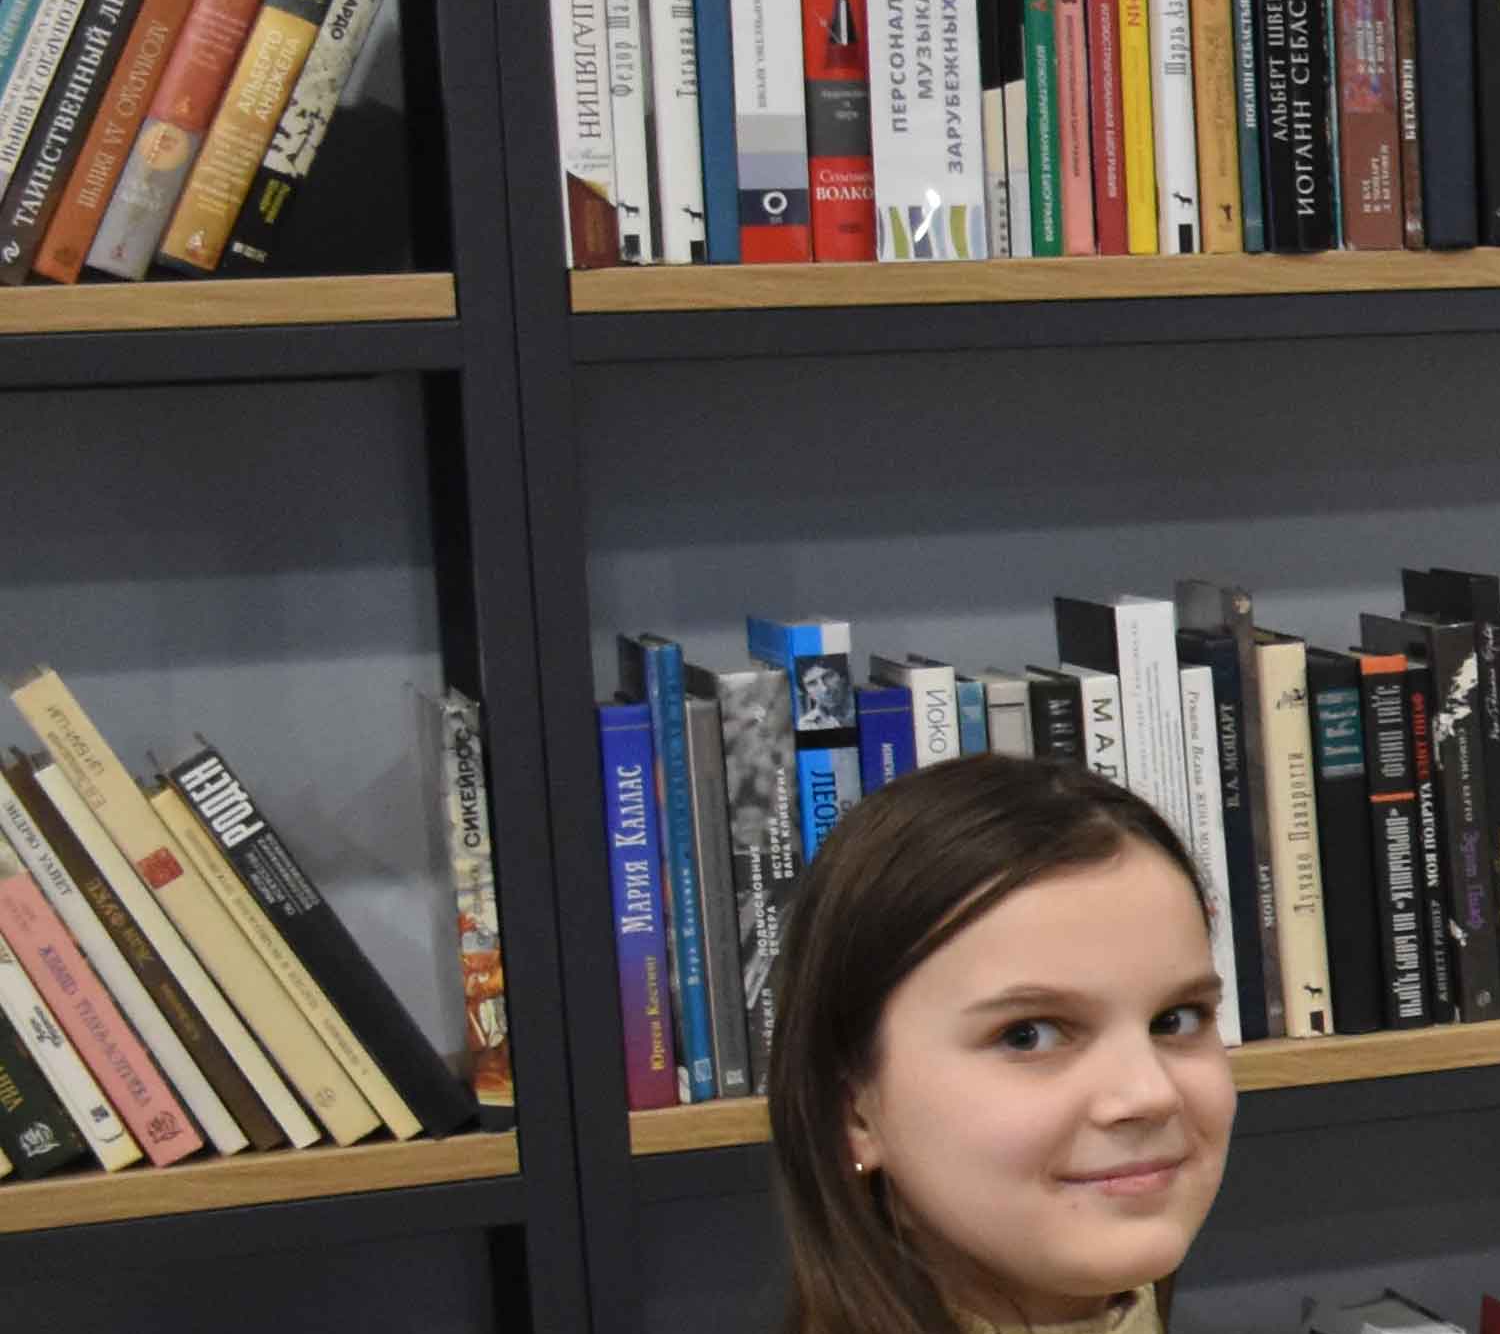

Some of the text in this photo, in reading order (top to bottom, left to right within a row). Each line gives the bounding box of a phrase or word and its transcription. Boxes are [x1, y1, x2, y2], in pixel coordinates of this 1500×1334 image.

[14, 26, 110, 228] ТАИНСТВЕННЫЙ
[1271, 57, 1288, 140] АЛЬБЕРТ
[1403, 59, 1416, 140] БЕТХОВЕН
[1296, 100, 1315, 215] ИОГАНН
[924, 688, 945, 754] ЙОКО
[179, 755, 266, 849] РОДЕН
[451, 728, 482, 848] СИКЕЙРОС
[752, 845, 766, 956] ПОДМОСКОВНЫЕ
[767, 905, 778, 955] ВЕЧЕРА
